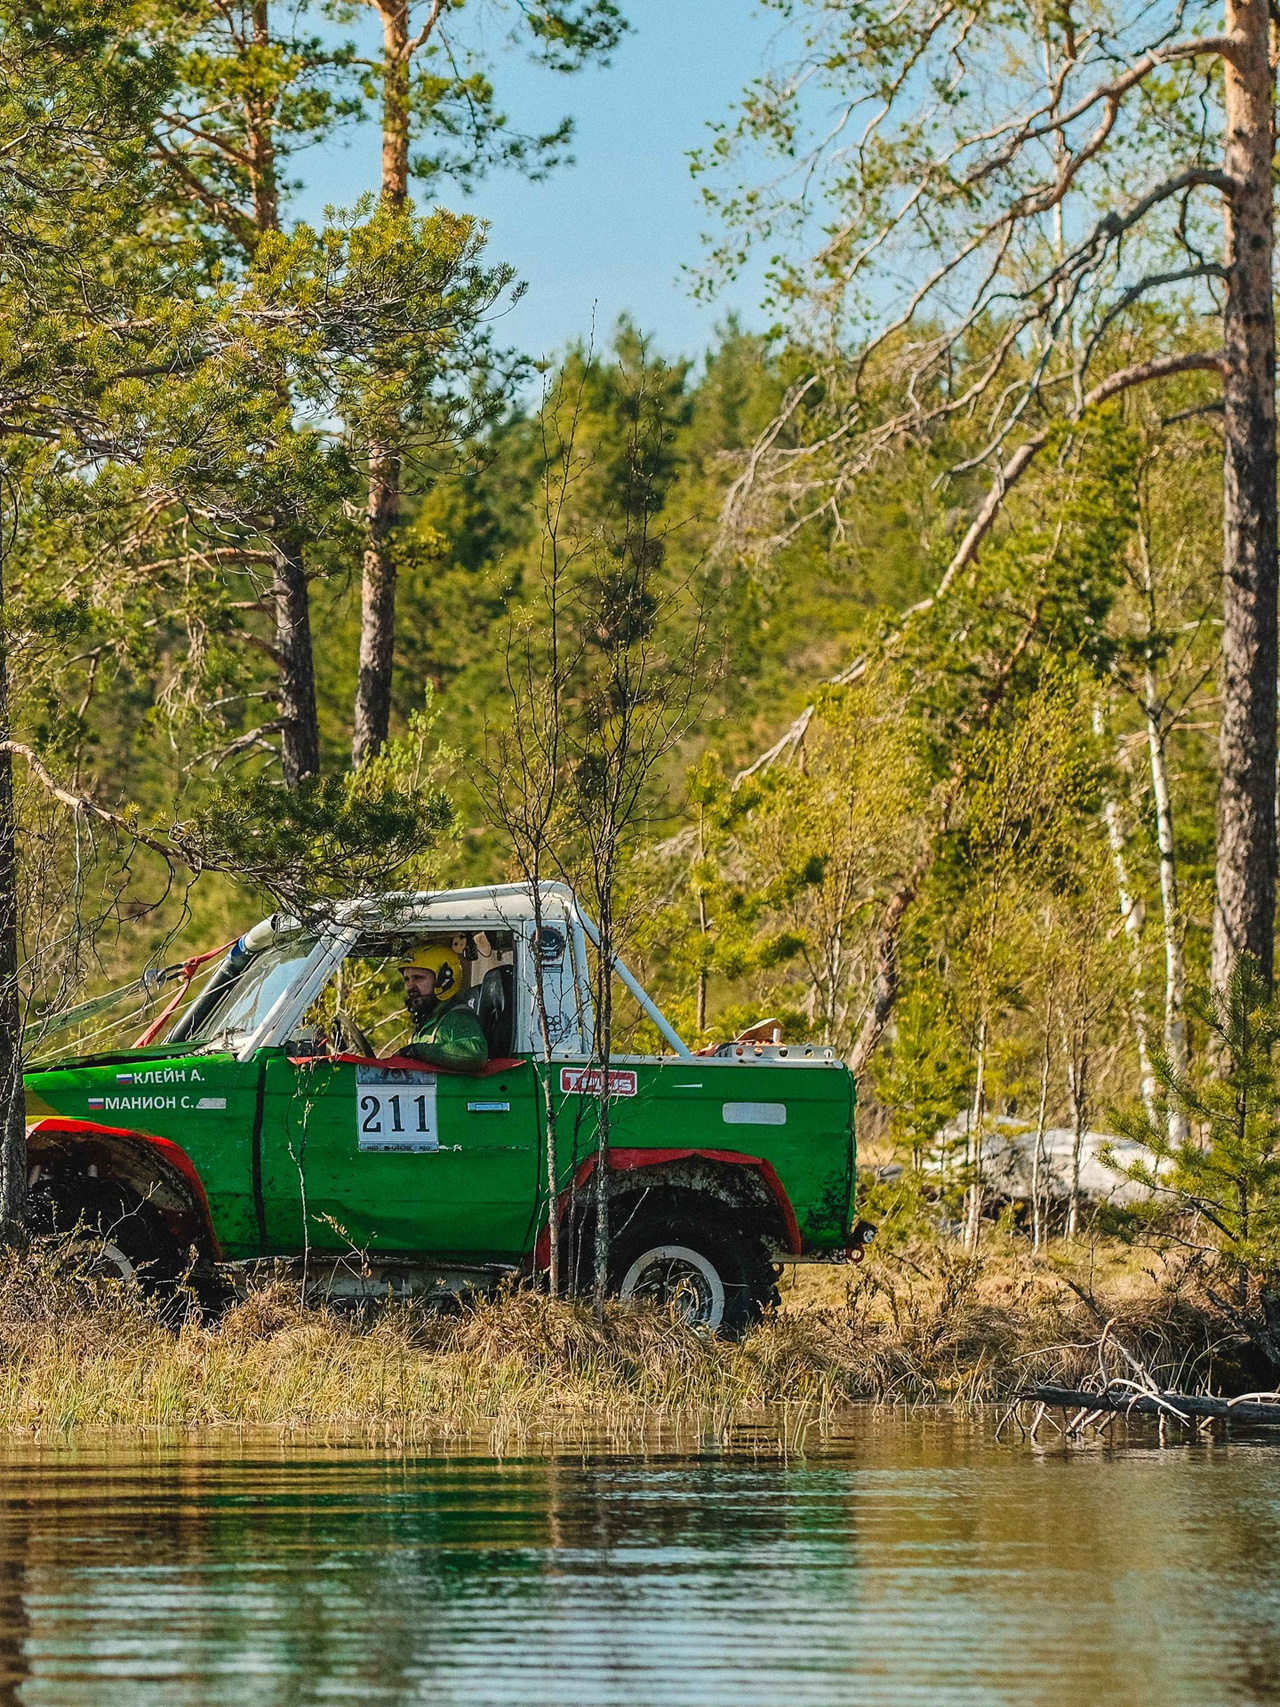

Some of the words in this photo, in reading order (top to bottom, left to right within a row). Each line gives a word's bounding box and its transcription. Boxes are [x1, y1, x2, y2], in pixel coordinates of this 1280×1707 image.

[133, 1068, 186, 1084] КЛЕЙН
[190, 1069, 206, 1082] А.
[105, 1096, 176, 1110] МАНИОН
[180, 1096, 194, 1109] С.
[360, 1095, 430, 1133] 211
